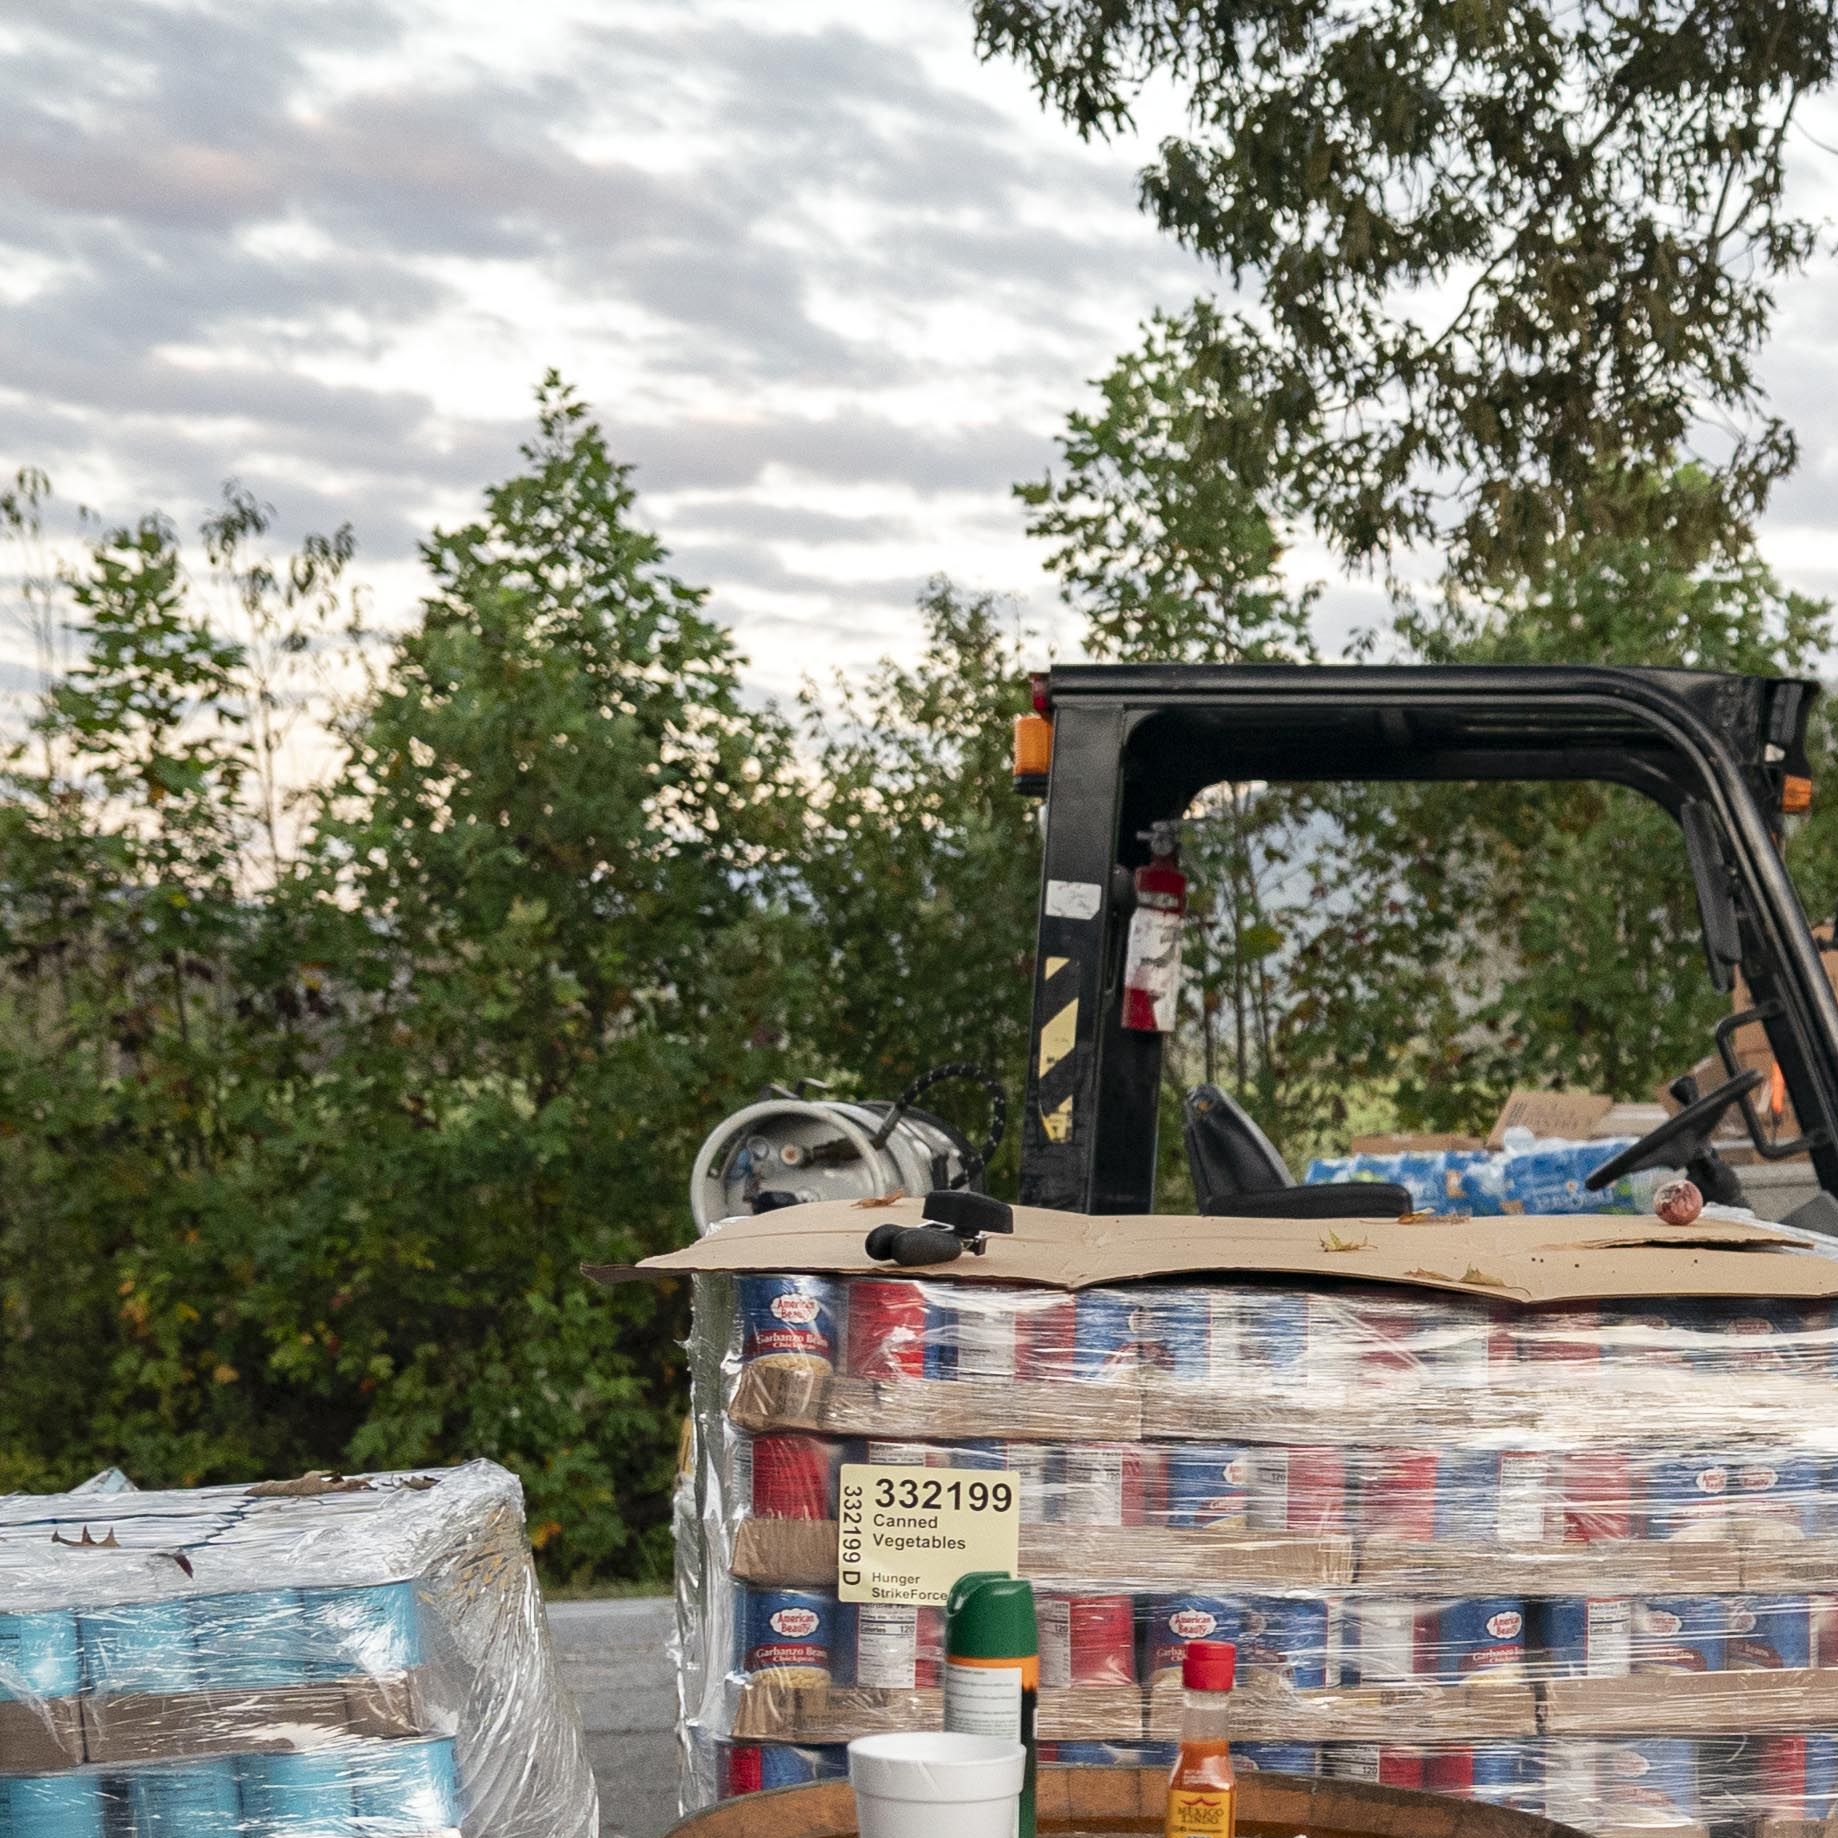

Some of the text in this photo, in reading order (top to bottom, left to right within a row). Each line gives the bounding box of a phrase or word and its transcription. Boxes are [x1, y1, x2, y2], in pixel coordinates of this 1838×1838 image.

[875, 1478, 1012, 1512] 332199
[873, 1514, 938, 1529] Canned
[843, 1485, 862, 1586] 332199 D
[873, 1533, 966, 1550] Vegetables
[872, 1572, 920, 1585] Hunger
[872, 1587, 948, 1601] StrikeForce
[777, 1613, 814, 1624] American
[1175, 1613, 1211, 1624] American
[781, 1622, 811, 1634] Beauty
[900, 1625, 914, 1633] 120
[756, 1646, 803, 1658] Garbanzo
